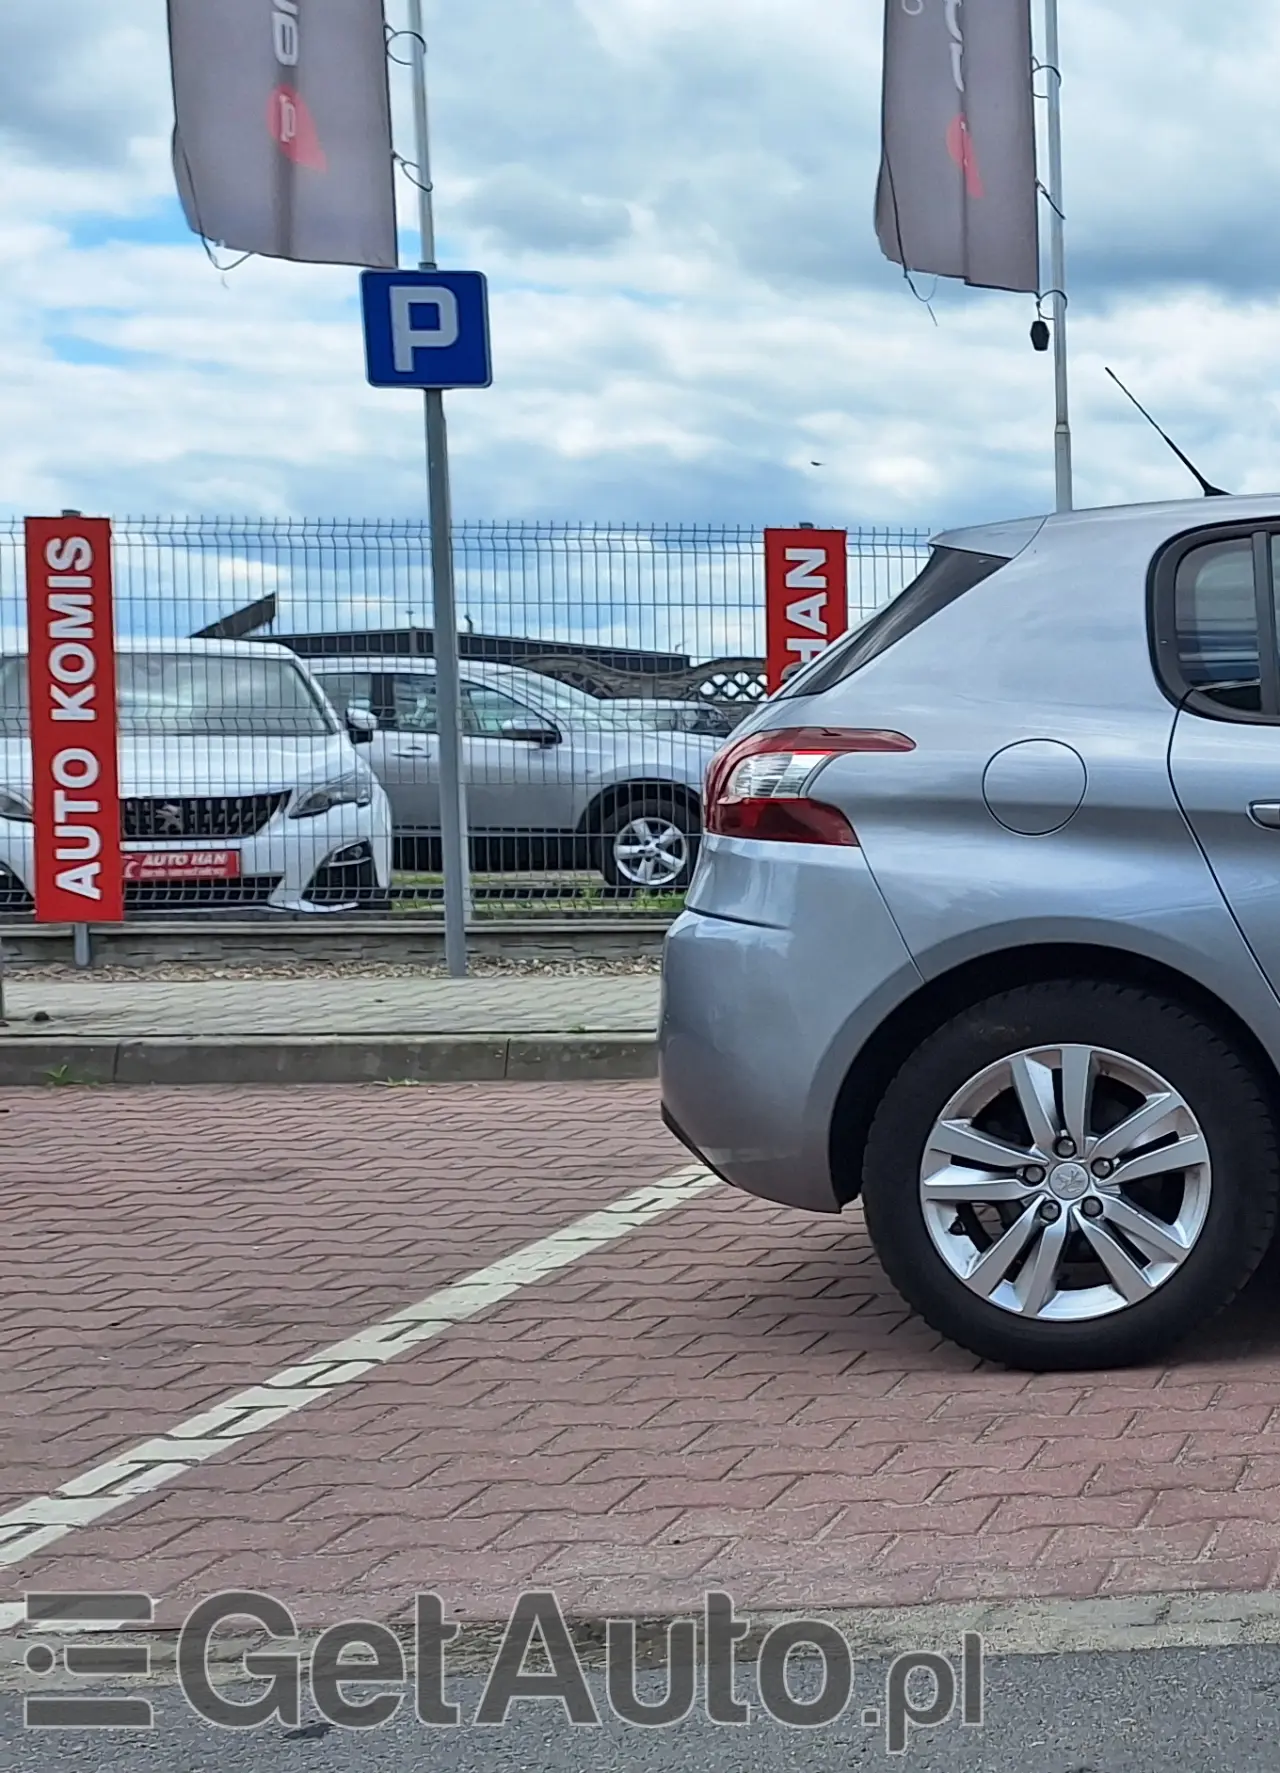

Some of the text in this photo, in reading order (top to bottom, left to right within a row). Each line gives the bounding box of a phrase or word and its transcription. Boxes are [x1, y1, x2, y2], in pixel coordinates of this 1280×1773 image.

[389, 286, 458, 373] P
[45, 536, 102, 901] AUTO KOMIS
[141, 853, 188, 867] AUTO
